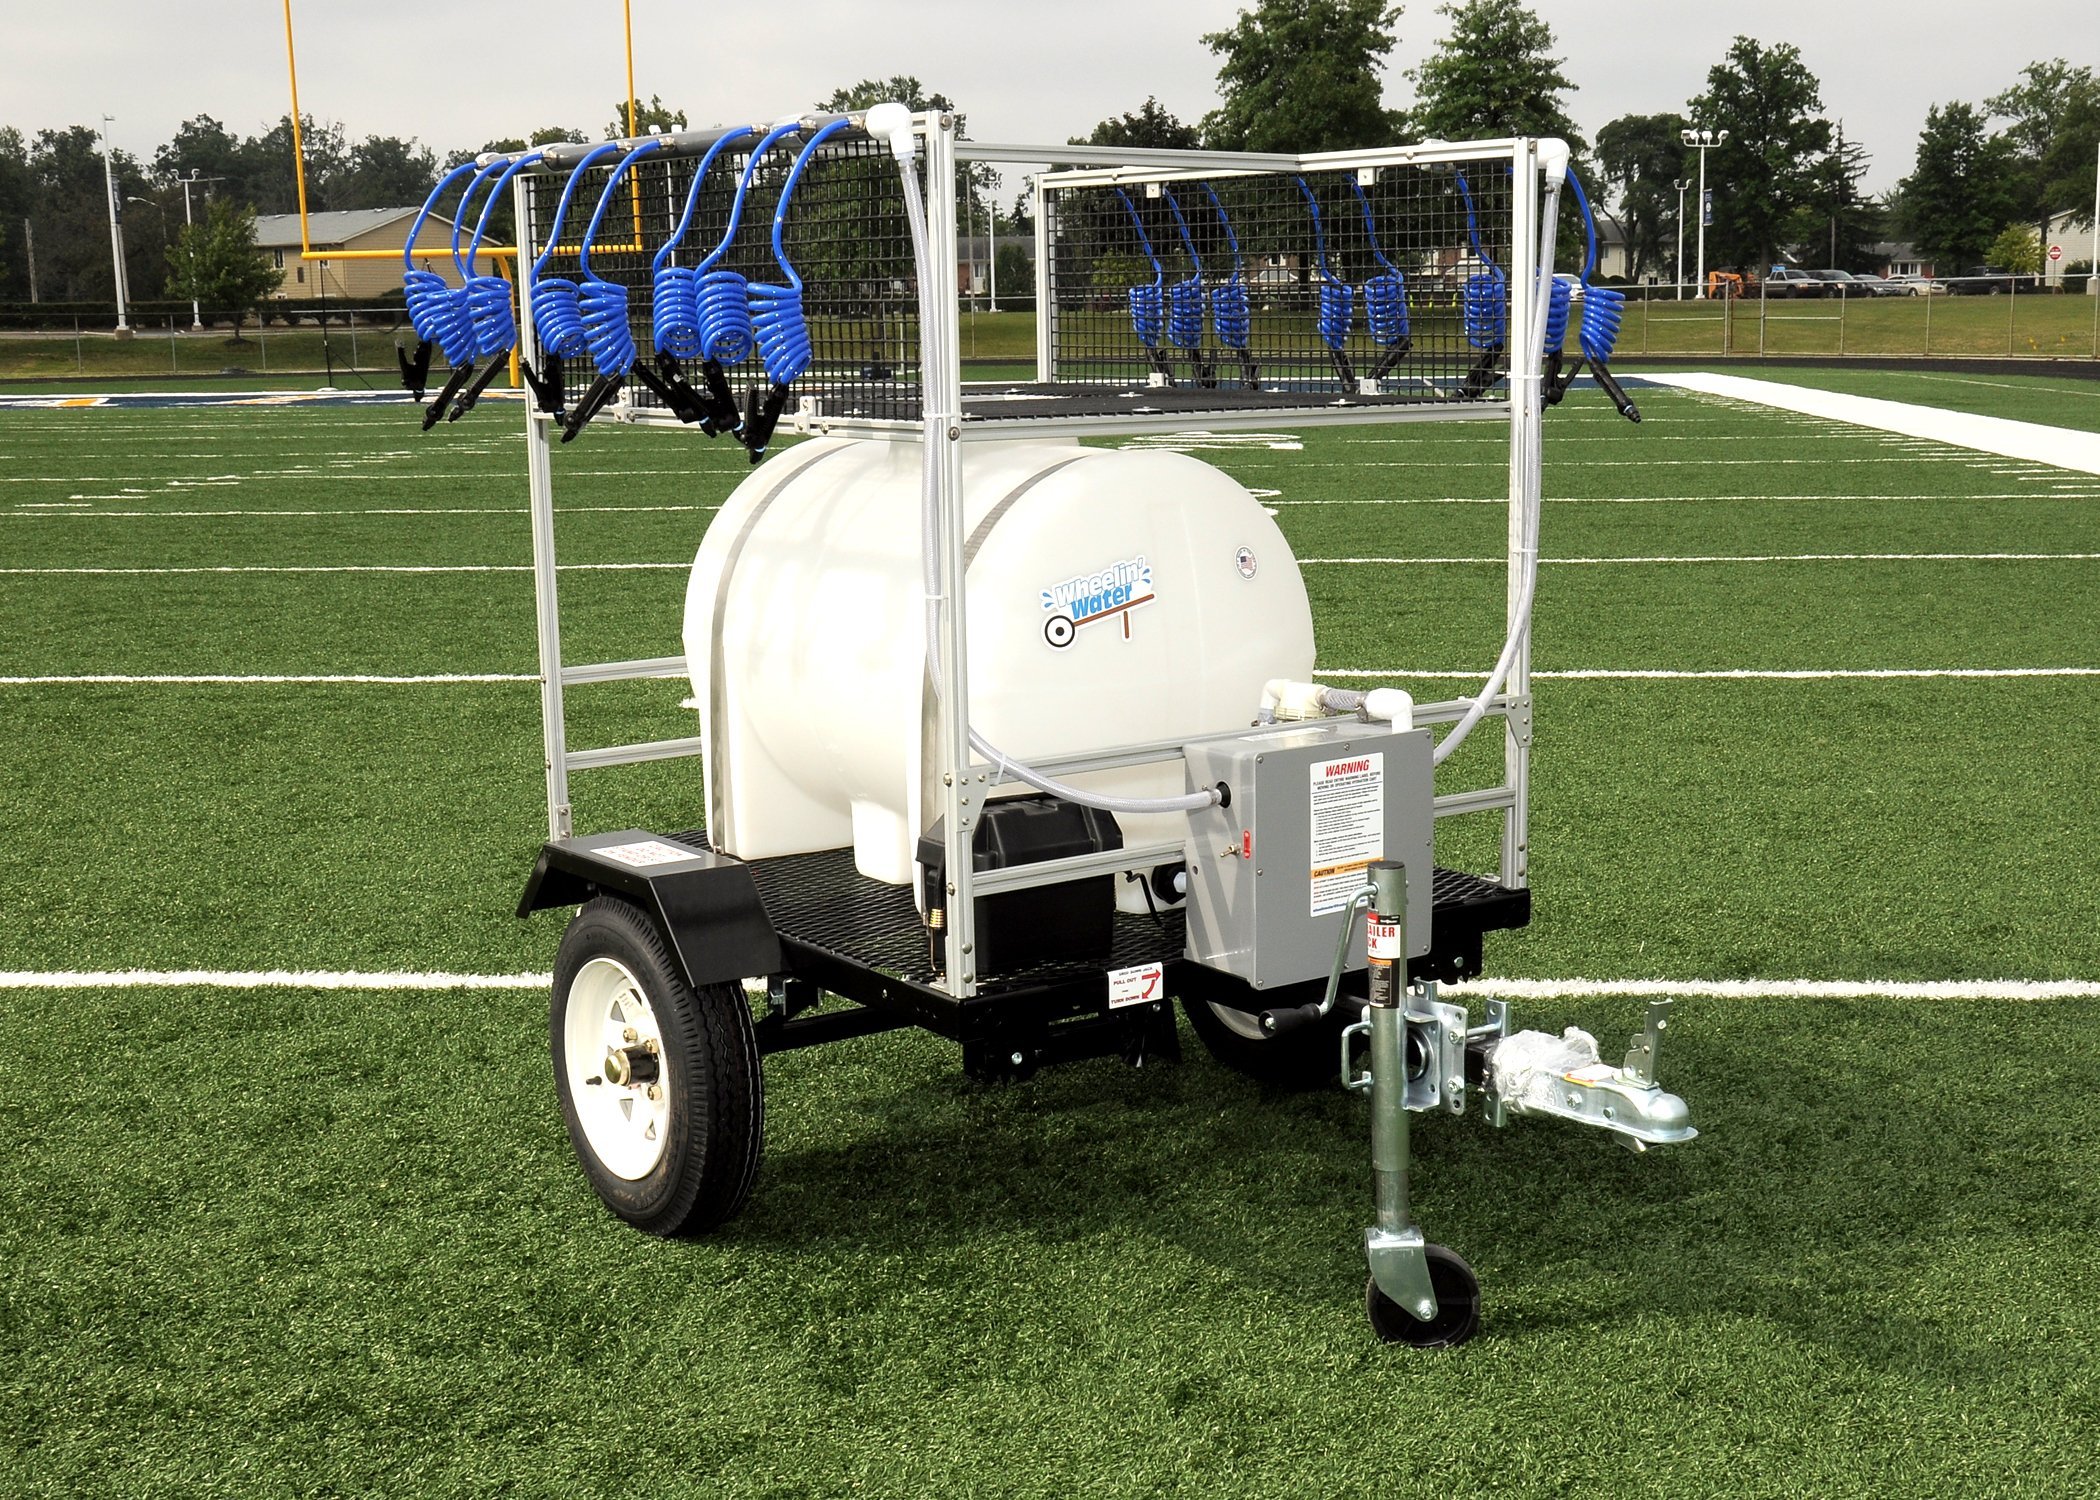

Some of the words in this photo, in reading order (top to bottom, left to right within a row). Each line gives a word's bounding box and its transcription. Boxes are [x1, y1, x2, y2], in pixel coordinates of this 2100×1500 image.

[1055, 557, 1143, 608] Wheelin'
[1071, 583, 1132, 619] Water
[1326, 760, 1369, 777] WARNING
[1314, 868, 1335, 877] CAUTION
